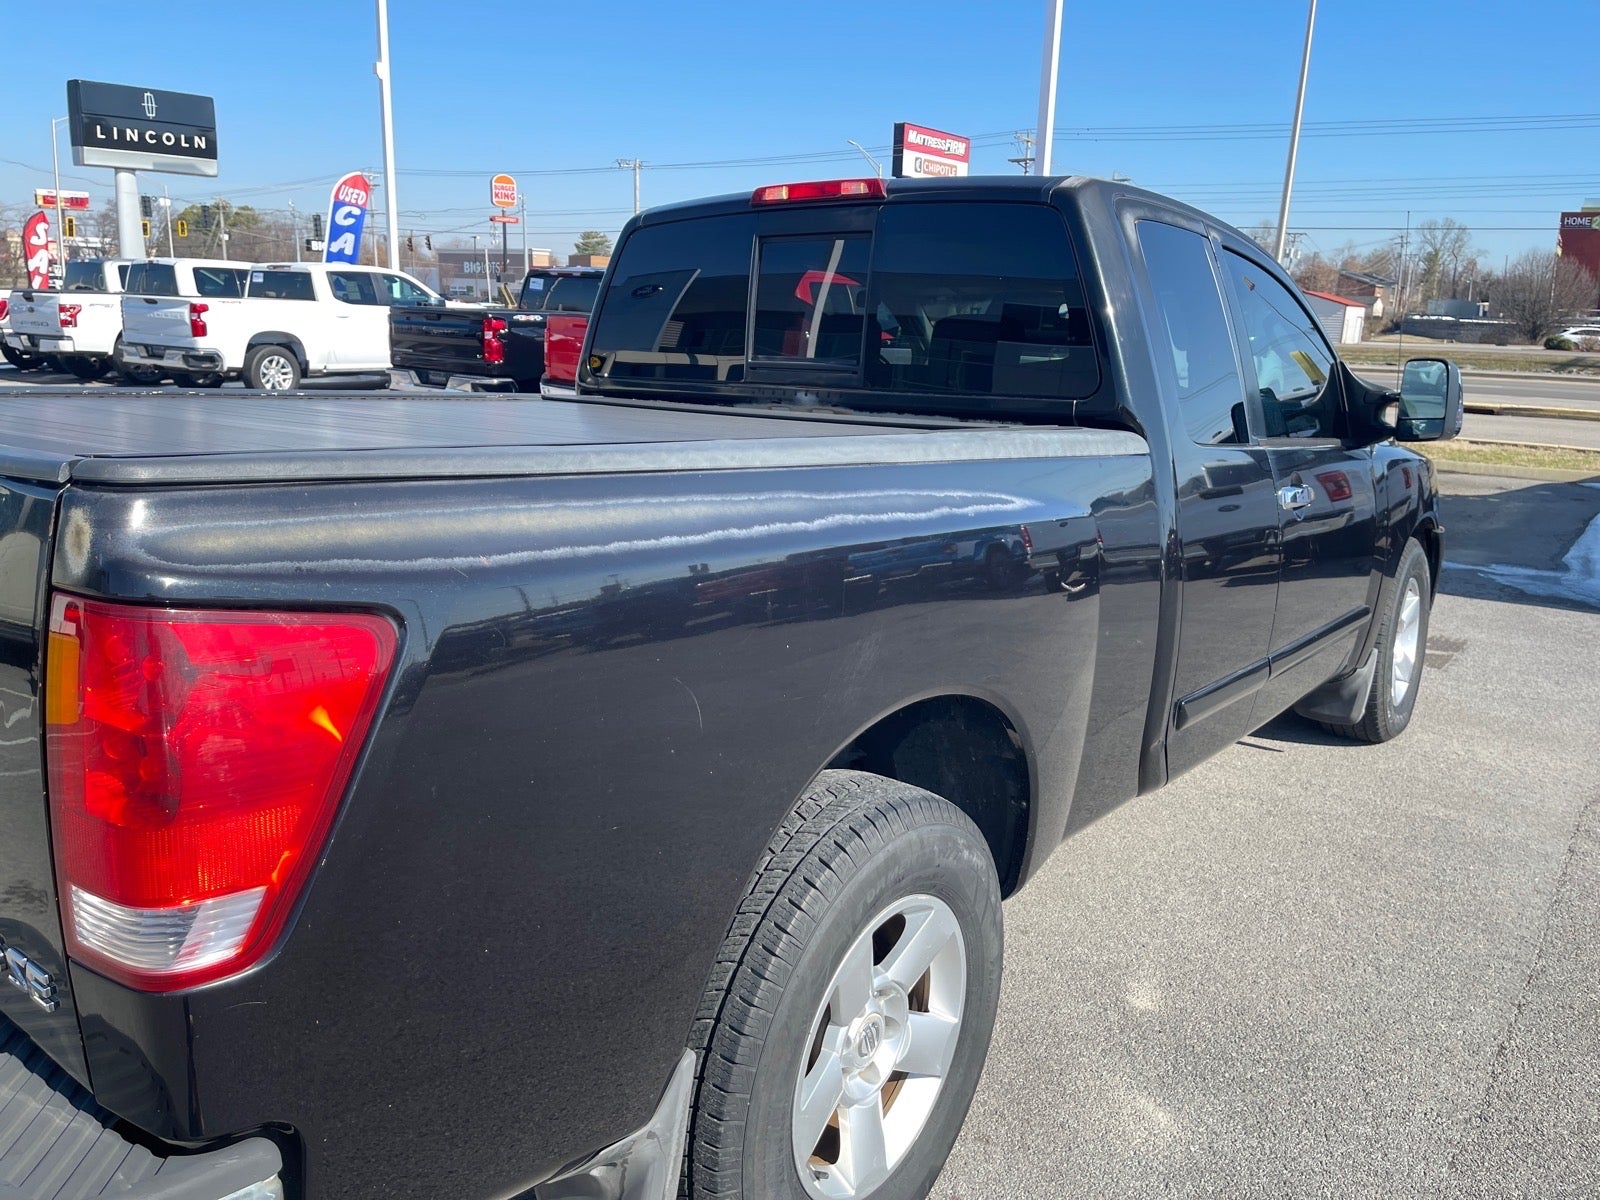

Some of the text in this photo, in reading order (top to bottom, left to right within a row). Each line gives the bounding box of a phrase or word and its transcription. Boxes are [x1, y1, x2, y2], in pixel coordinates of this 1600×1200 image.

[96, 125, 206, 149] LINCOLN
[924, 161, 957, 176] CHIPOTLE
[338, 185, 367, 205] USED
[494, 191, 516, 200] KING
[1564, 216, 1592, 225] HOME
